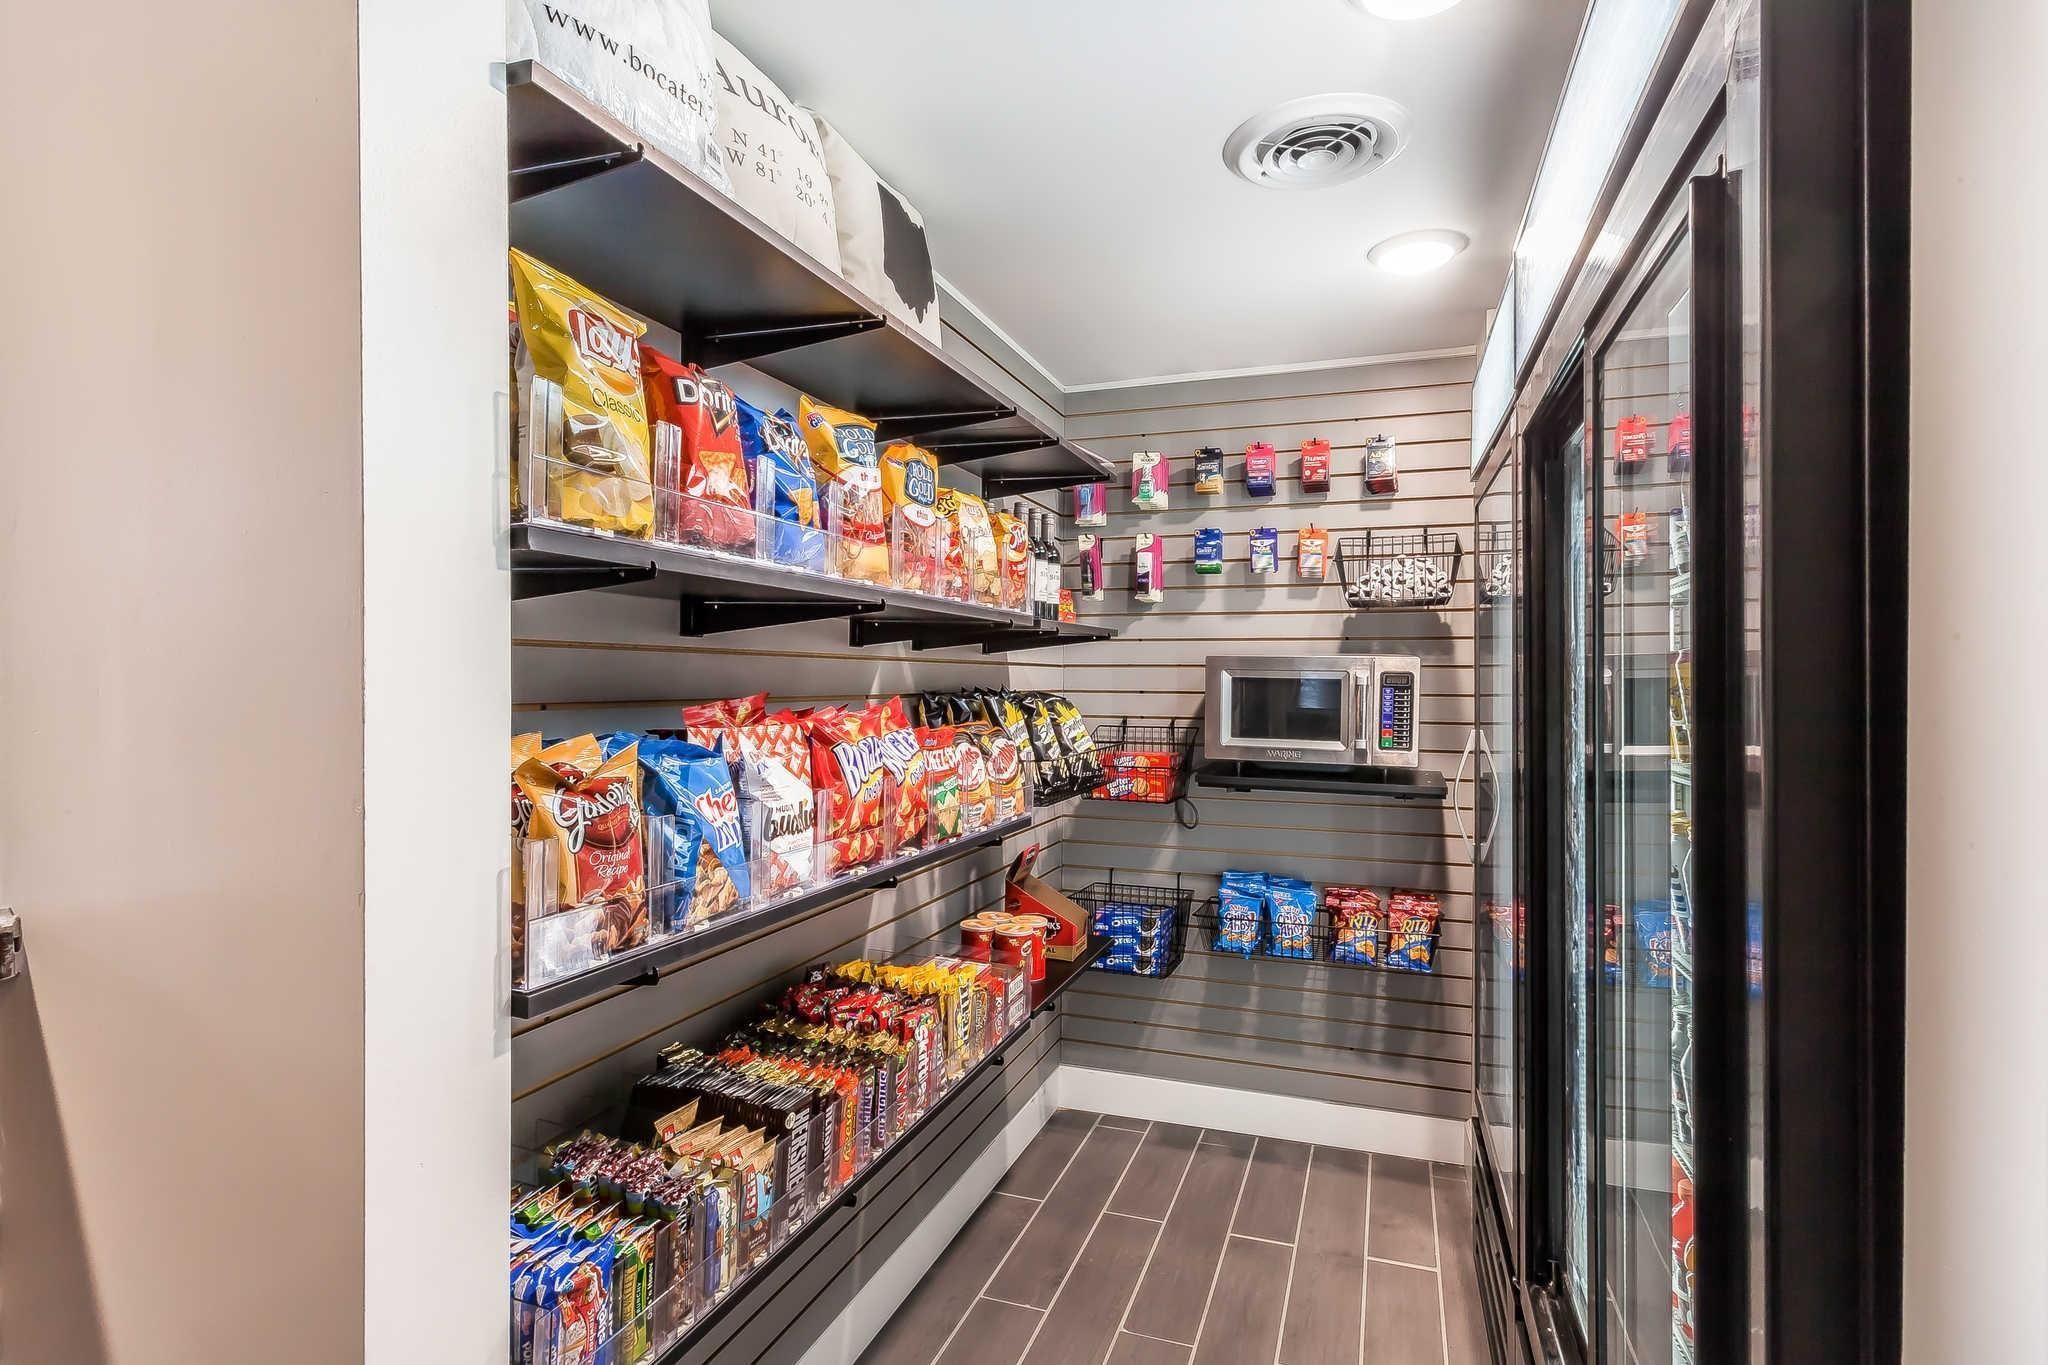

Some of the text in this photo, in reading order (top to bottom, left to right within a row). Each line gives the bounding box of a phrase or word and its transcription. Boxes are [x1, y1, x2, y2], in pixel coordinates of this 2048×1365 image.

[731, 128, 748, 147] N
[726, 146, 745, 167] W
[592, 388, 642, 422] Classic
[910, 461, 933, 482] ROLD
[908, 477, 934, 501] GOLD
[589, 847, 631, 868] Original
[594, 863, 629, 879] Recipe
[1112, 919, 1138, 927] OREO
[1350, 913, 1377, 931] RITZ
[1400, 919, 1430, 934] RITZ
[788, 1107, 810, 1218] HERSHEY'S
